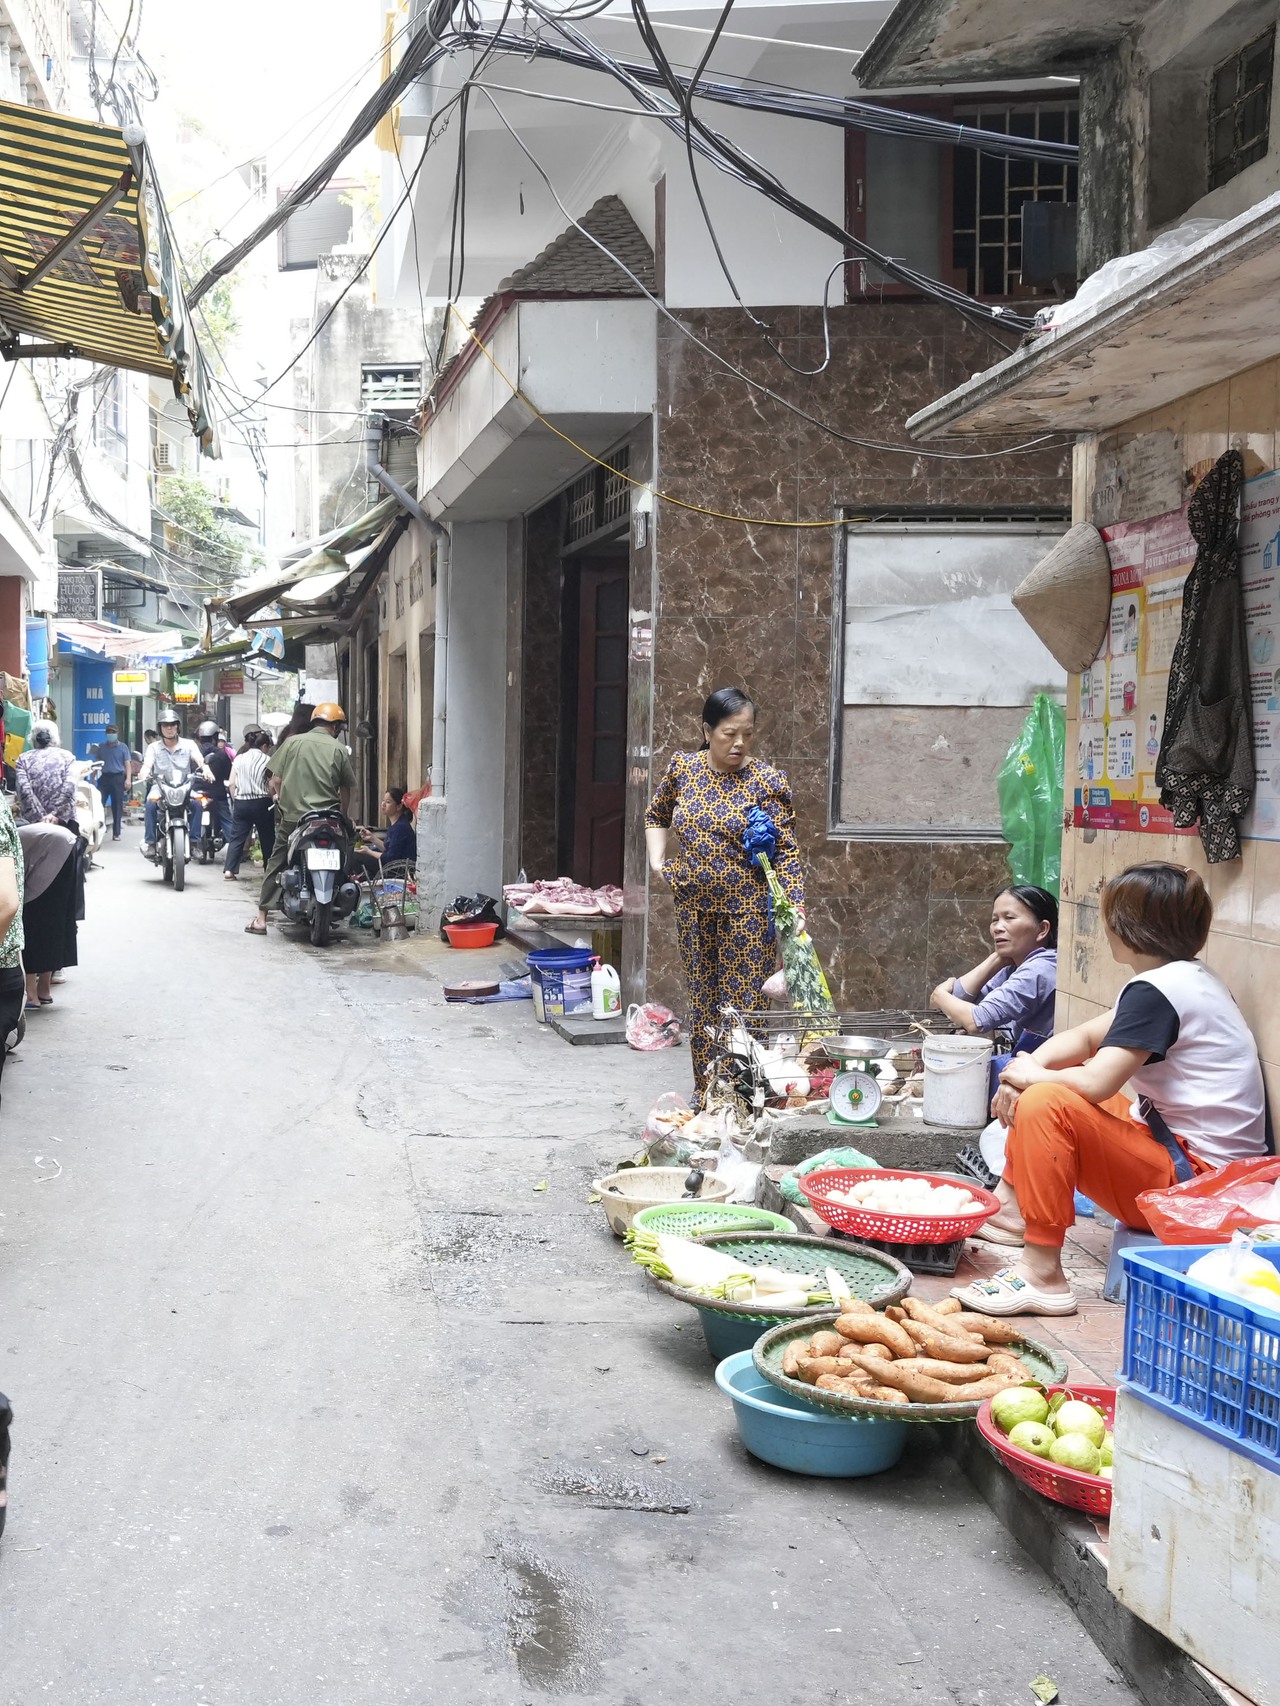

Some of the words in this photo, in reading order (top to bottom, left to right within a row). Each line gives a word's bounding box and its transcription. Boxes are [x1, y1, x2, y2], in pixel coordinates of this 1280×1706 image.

[1258, 497, 1275, 506] trang
[1251, 509, 1271, 522] phòng
[86, 686, 104, 699] NHÀ
[82, 709, 110, 725] THUỐC
